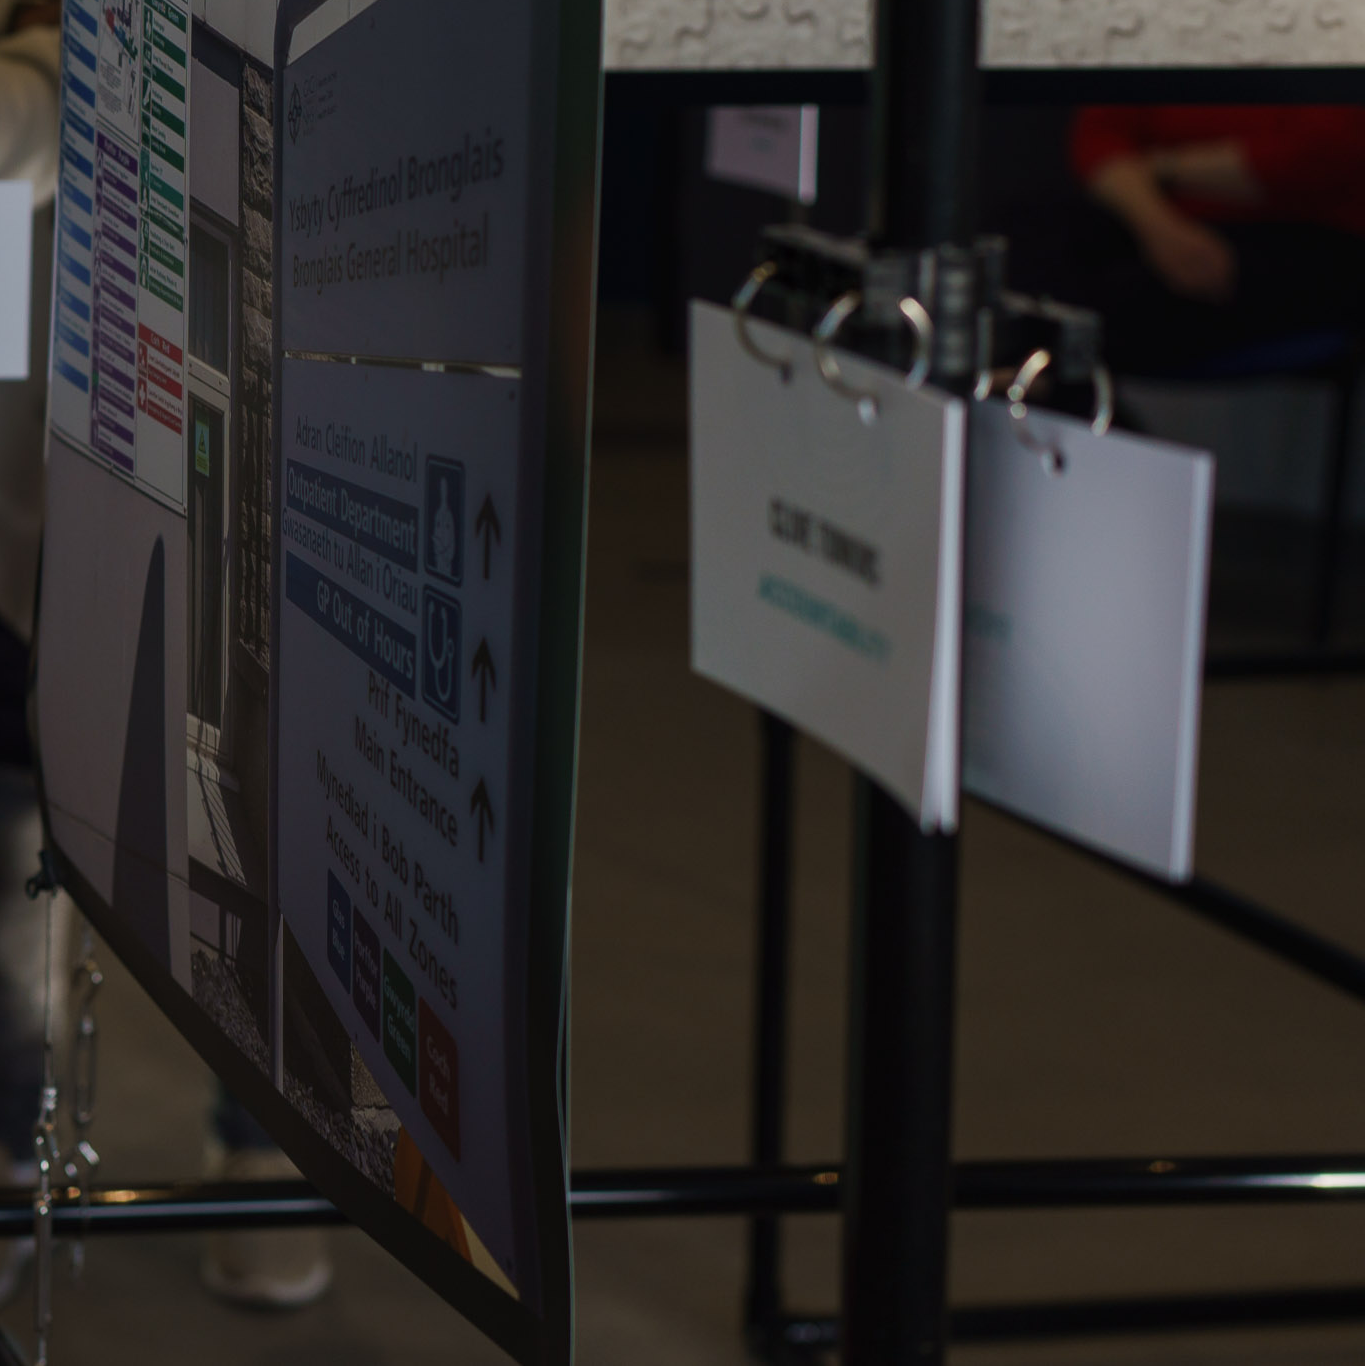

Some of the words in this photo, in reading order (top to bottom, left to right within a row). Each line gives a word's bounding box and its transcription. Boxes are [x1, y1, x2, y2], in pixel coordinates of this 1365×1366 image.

[288, 195, 325, 236] Ysbyty
[326, 156, 403, 231] Cyffredinol
[407, 125, 506, 202] Bronglais
[292, 245, 343, 296] Bronglais
[346, 229, 401, 282] General
[406, 211, 490, 285] Hospital
[295, 414, 323, 453] Adran
[325, 419, 367, 466] Cleifion
[369, 434, 418, 483] Allanol
[287, 468, 338, 518] Outpatient
[339, 486, 417, 556] Department
[282, 505, 332, 565] Gwasanaeth
[334, 539, 345, 572] tu
[346, 543, 374, 590] Allan
[383, 562, 418, 615] Oriau
[316, 579, 331, 615] GP
[333, 589, 354, 635] Out
[356, 608, 372, 647] of
[373, 618, 415, 680] Hours
[368, 670, 392, 718] Prif
[394, 688, 460, 779] Fynedfa
[354, 715, 385, 776] Main
[390, 750, 459, 847] Entrance
[316, 749, 369, 840] Mynediad
[381, 827, 409, 884] Bob
[414, 860, 460, 946] Parth
[325, 813, 361, 884] Access
[364, 865, 380, 910] to
[384, 889, 403, 941] All
[408, 916, 459, 1010] Zones
[331, 929, 345, 961] Blue
[385, 1014, 414, 1066] Green
[425, 1033, 452, 1079] Coch
[427, 1072, 450, 1118] Red
